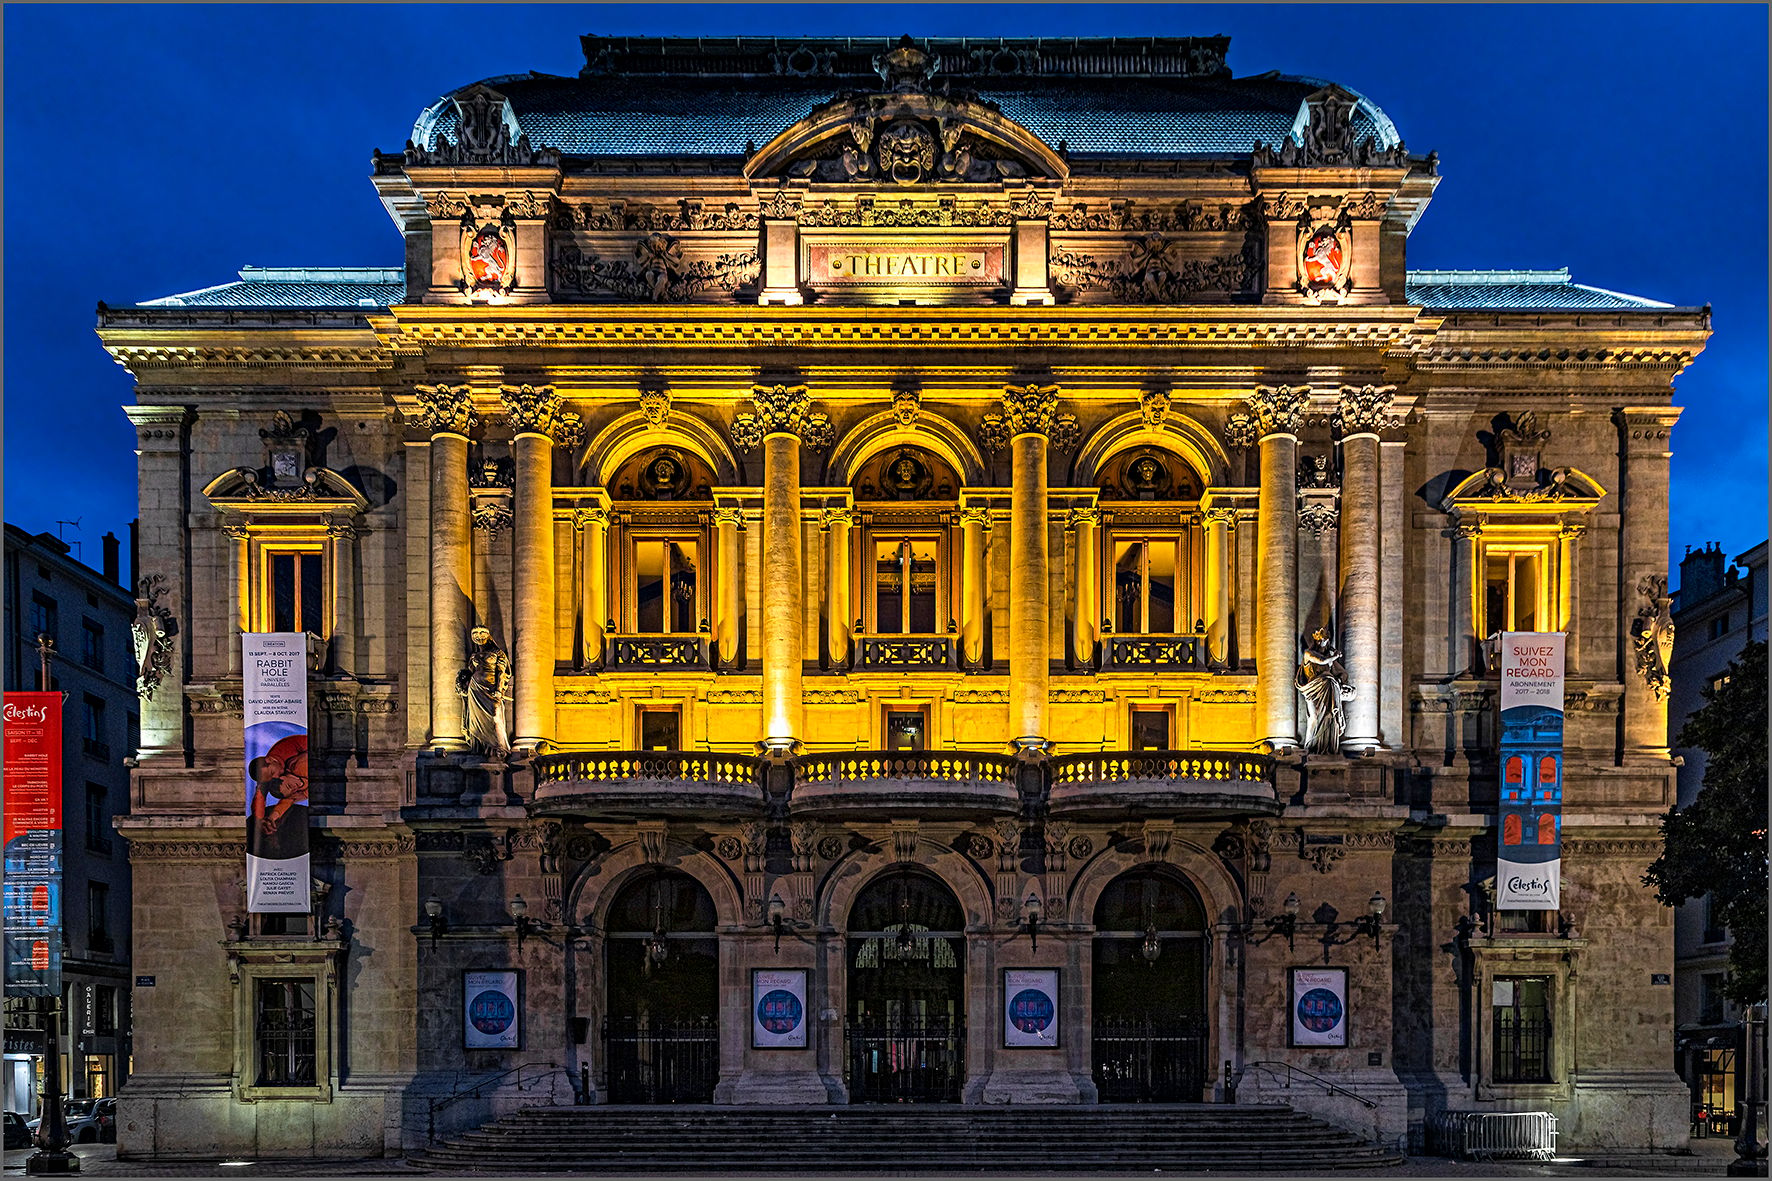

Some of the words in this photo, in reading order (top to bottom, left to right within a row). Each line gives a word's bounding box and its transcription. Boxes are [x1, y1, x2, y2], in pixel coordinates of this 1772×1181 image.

[846, 255, 967, 275] THEATRE
[1513, 646, 1553, 656] SUIVEZ
[257, 659, 293, 668] RABBIT
[1520, 657, 1547, 667] MON
[261, 668, 288, 677] HOLE
[3, 703, 48, 723] Célestins
[1508, 876, 1550, 895] Célestins
